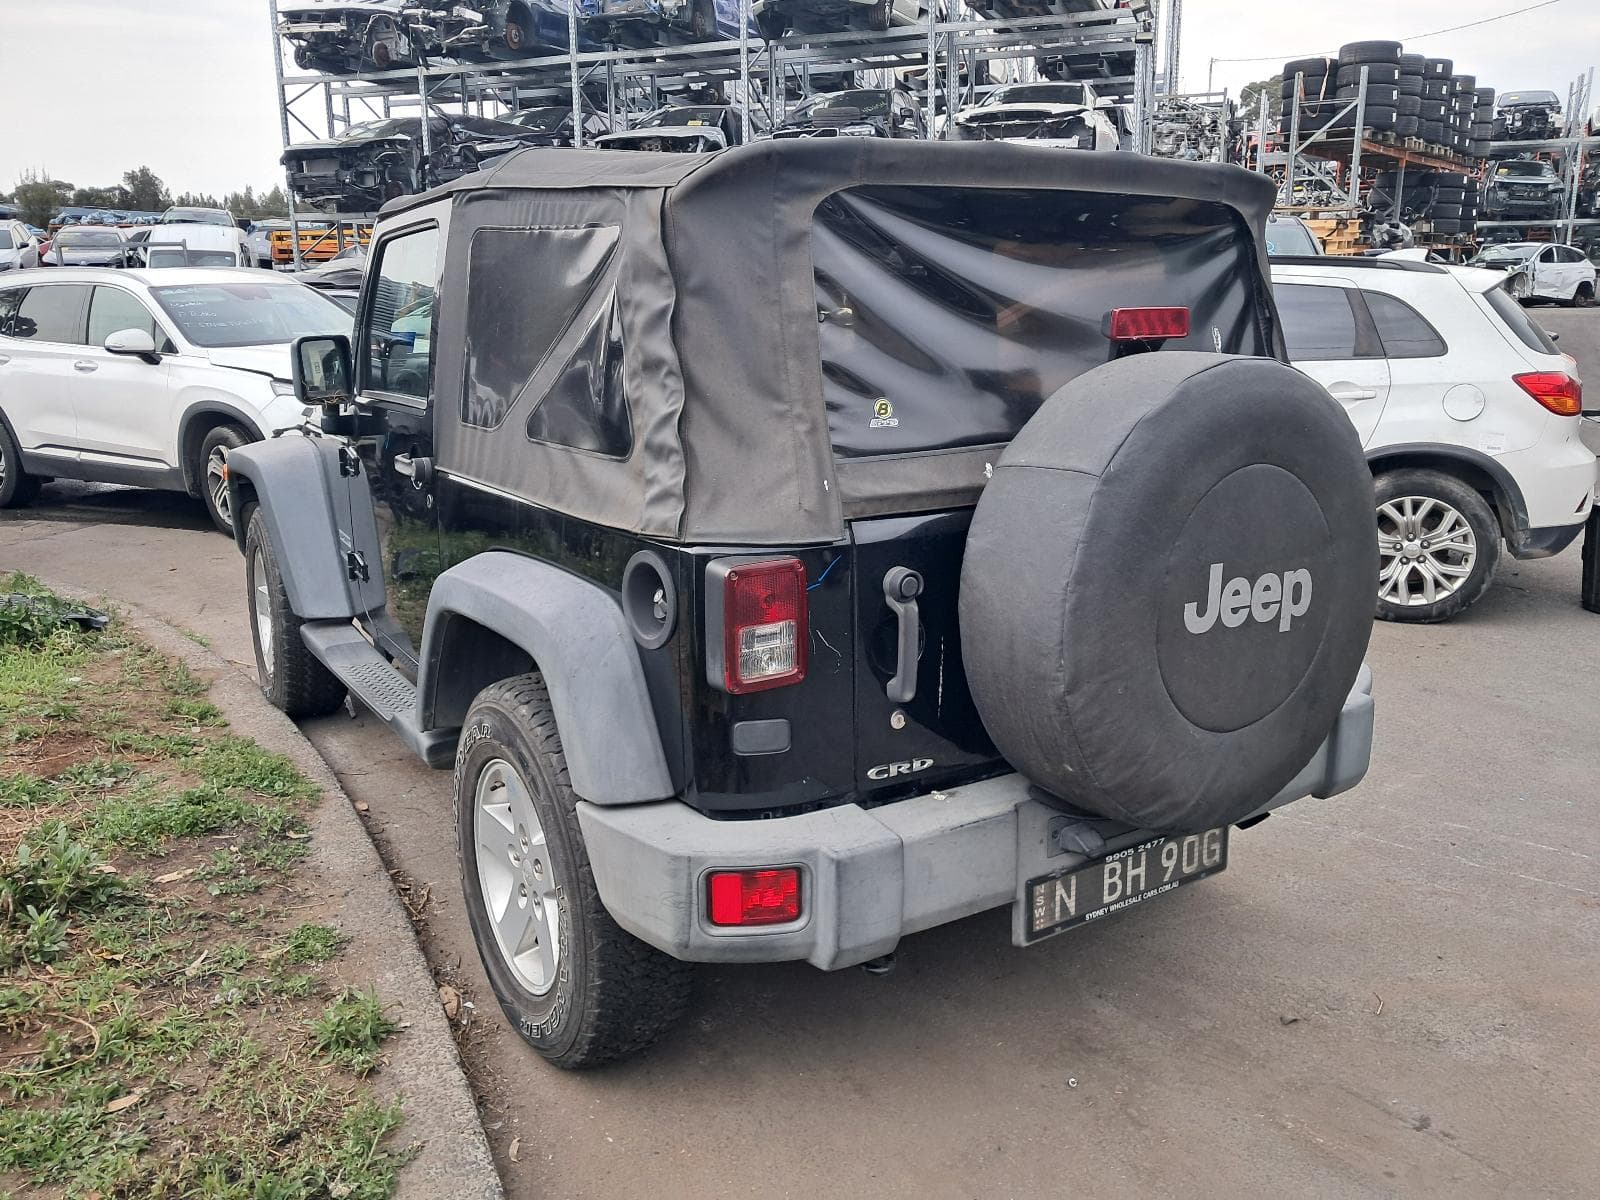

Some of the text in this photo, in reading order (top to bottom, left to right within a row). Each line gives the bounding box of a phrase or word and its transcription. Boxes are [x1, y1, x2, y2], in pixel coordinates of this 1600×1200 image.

[1184, 562, 1312, 633] Jeep
[867, 758, 934, 780] CRD
[1105, 837, 1166, 863] 9905 2477
[1103, 851, 1147, 904] BH
[1161, 828, 1221, 882] 90G
[1085, 906, 1109, 921] SYDNEY
[1109, 894, 1142, 912] WHOLESALE
